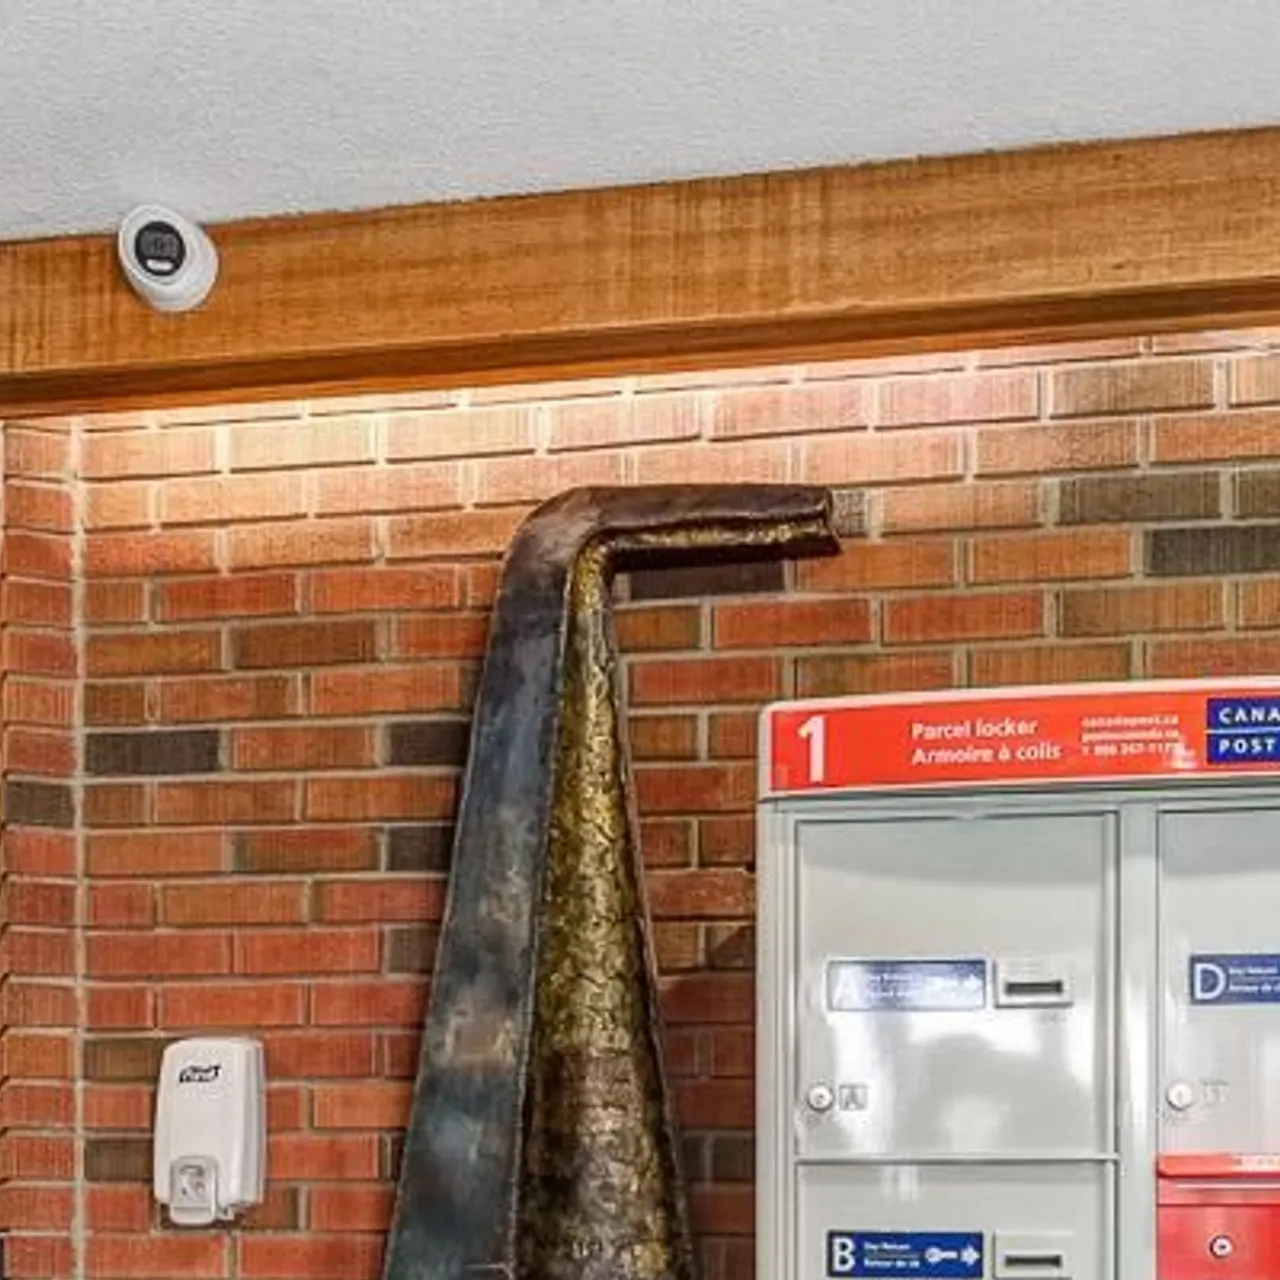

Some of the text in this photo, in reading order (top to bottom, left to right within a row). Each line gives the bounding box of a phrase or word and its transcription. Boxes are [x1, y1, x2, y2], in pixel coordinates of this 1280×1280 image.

[911, 718, 1037, 740] Parcel locker
[797, 714, 825, 782] 1
[911, 740, 1061, 765] Armoire à colis
[1219, 738, 1277, 755] POST
[1193, 962, 1227, 999] D
[832, 1237, 856, 1272] B
